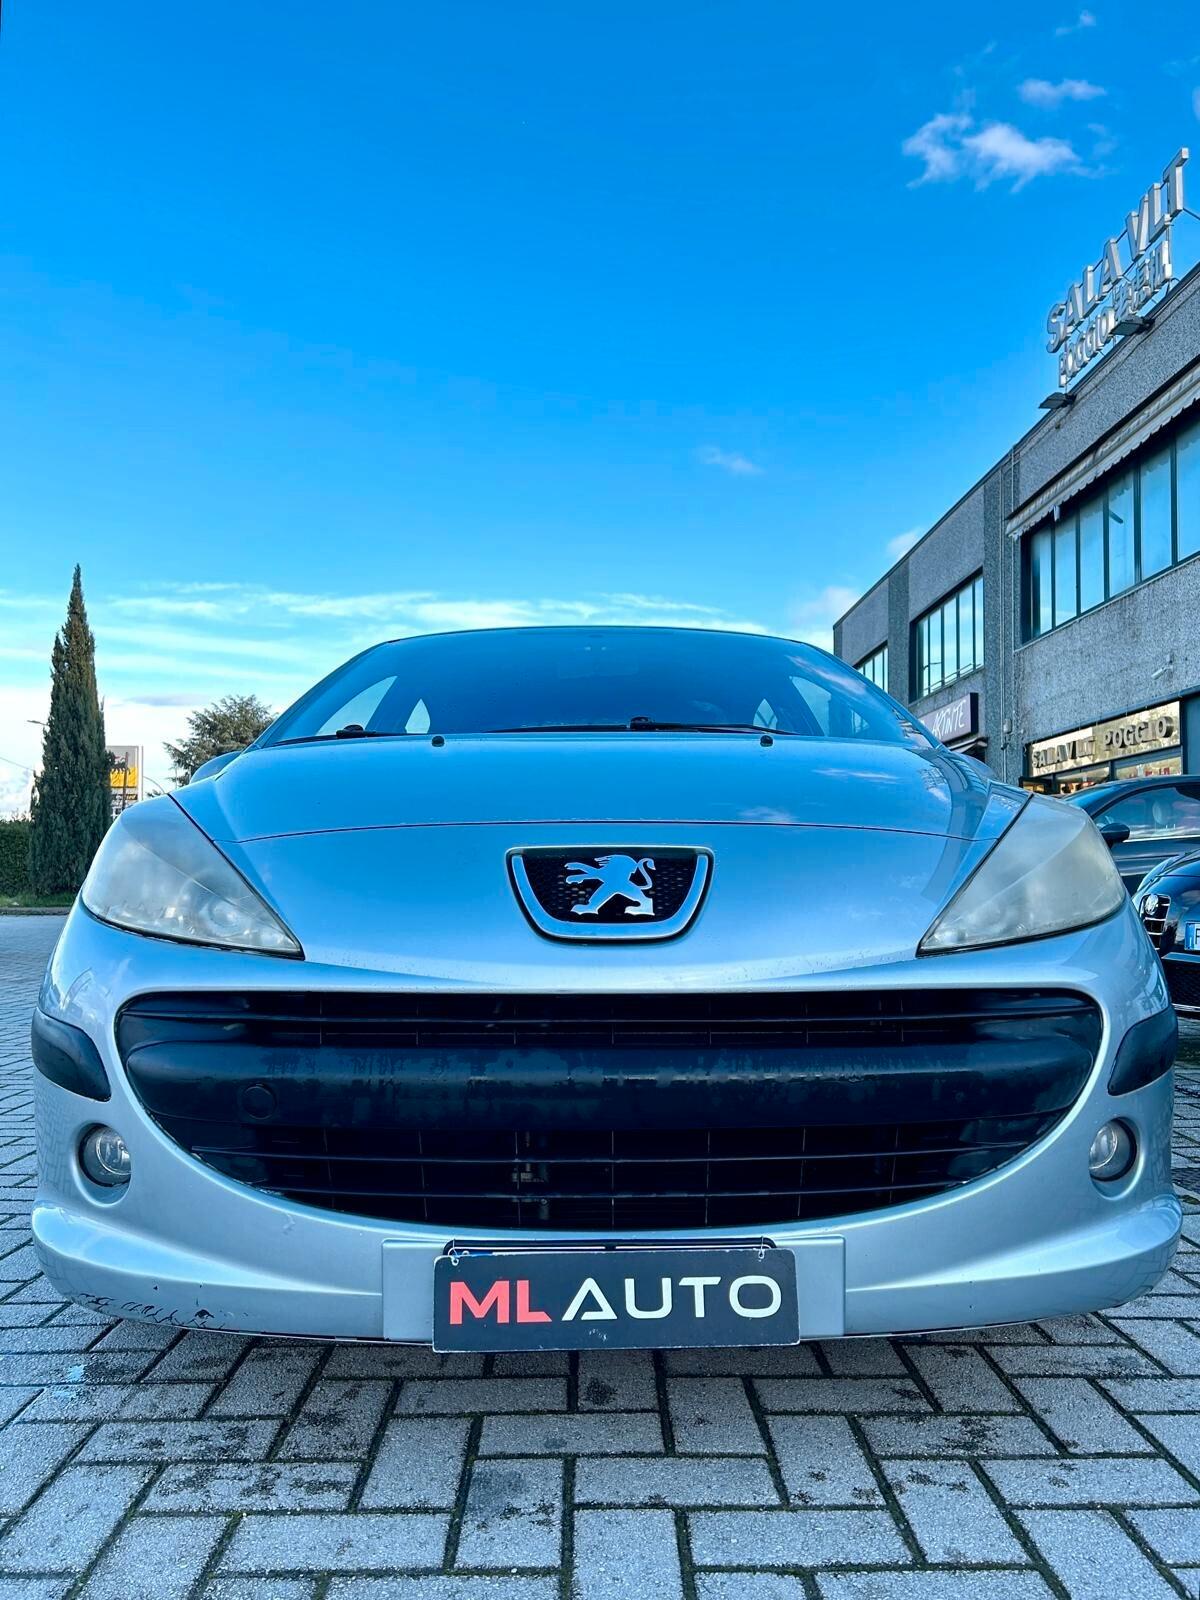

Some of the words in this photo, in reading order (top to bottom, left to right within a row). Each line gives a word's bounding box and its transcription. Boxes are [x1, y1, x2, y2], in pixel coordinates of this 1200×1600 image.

[1046, 238, 1124, 353] SALA
[1125, 147, 1189, 262] VLT
[1058, 306, 1116, 388] POGGIO
[1031, 744, 1068, 768] SALA
[1103, 716, 1174, 750] POGGIO
[449, 1280, 552, 1325] ML
[561, 1275, 782, 1320] AUTO
